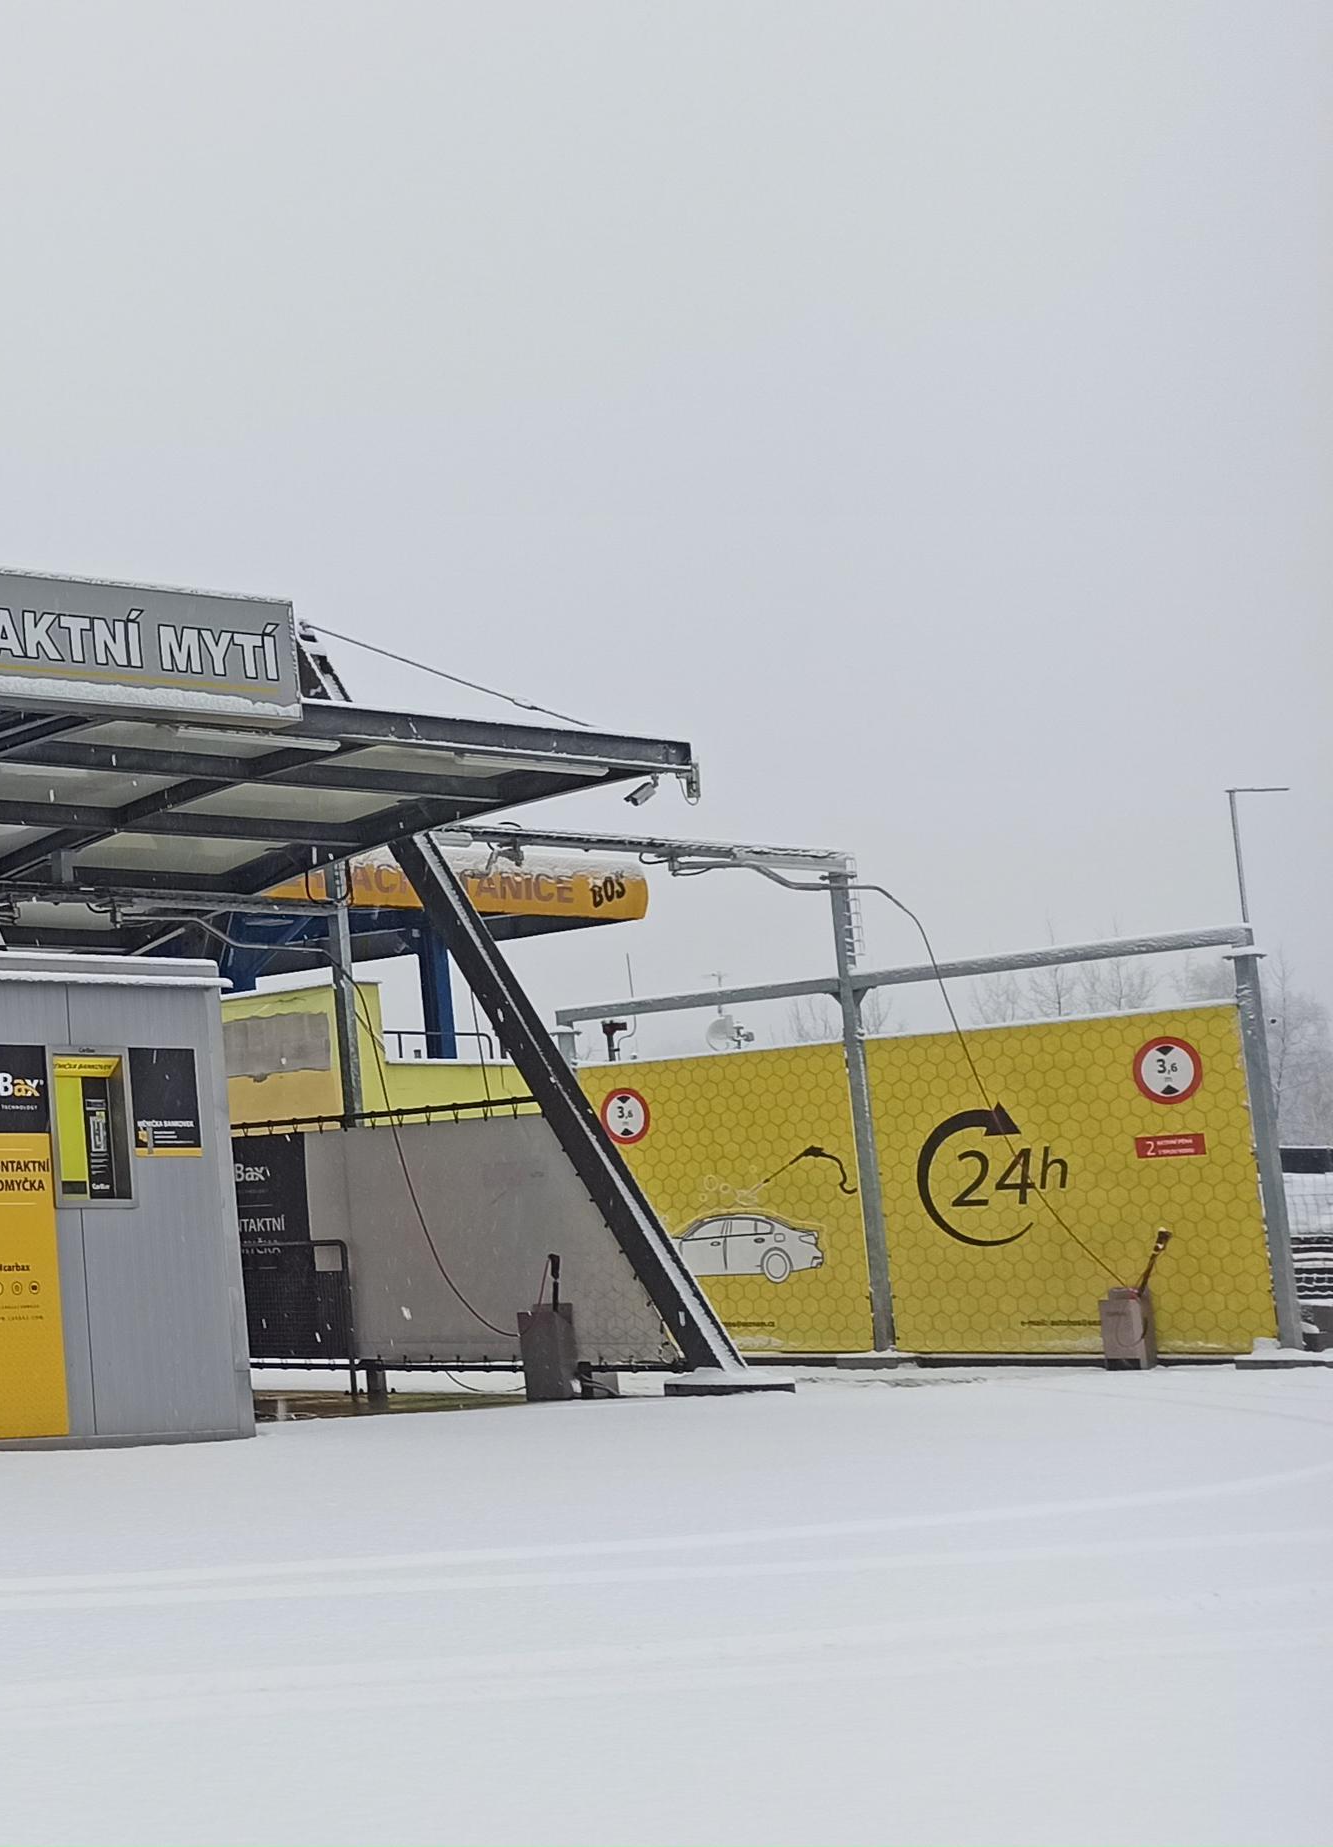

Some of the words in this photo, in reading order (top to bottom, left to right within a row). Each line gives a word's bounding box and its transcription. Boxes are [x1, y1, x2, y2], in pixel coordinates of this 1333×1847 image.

[159, 622, 281, 681] MYTÍ
[1144, 1140, 1156, 1156] 2
[234, 1162, 266, 1183] Bax
[950, 1145, 1069, 1208] 24h
